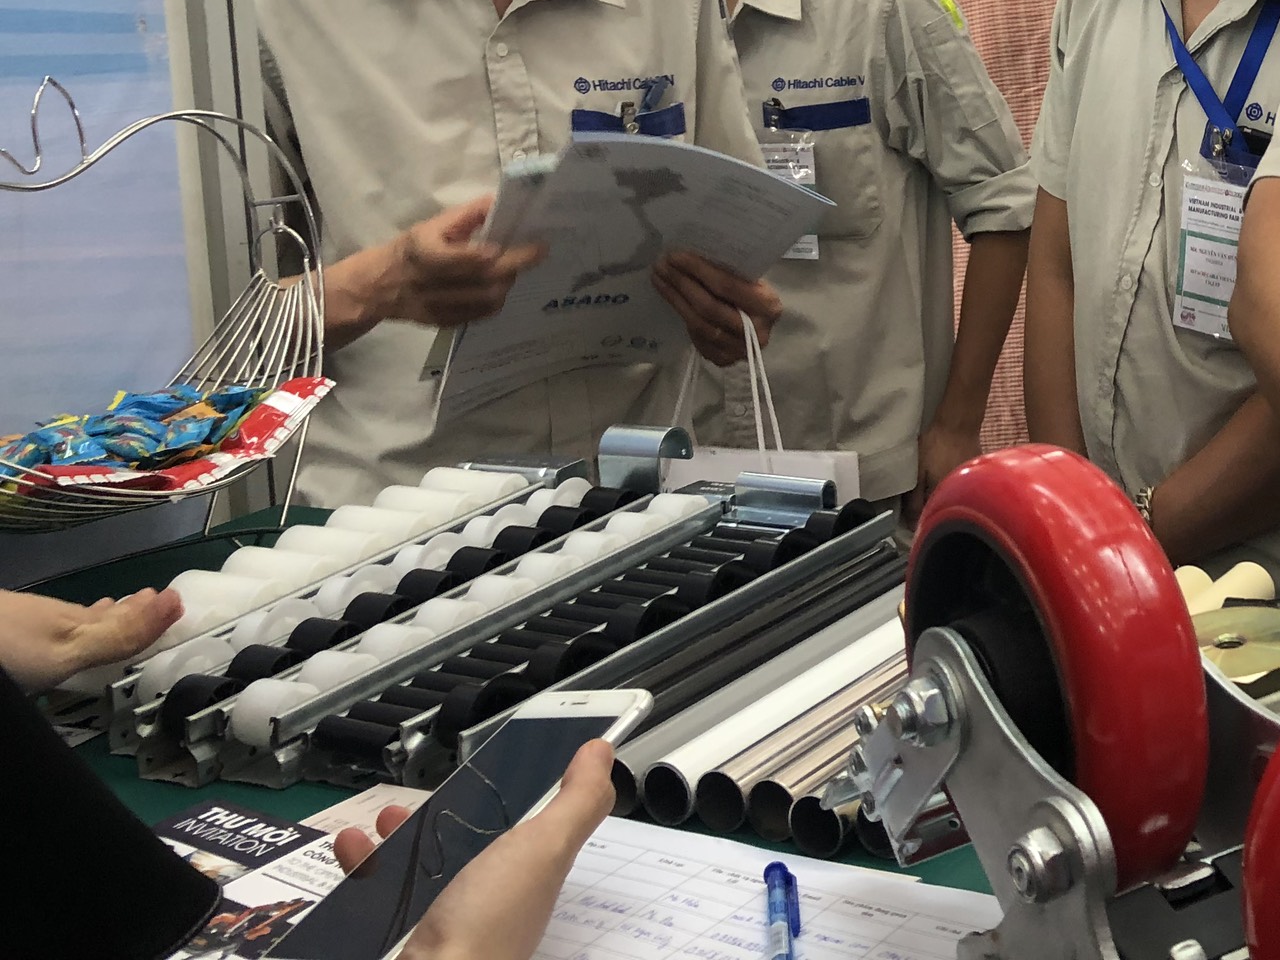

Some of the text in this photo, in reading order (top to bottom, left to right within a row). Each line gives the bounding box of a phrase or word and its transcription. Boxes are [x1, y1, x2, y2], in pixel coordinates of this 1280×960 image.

[592, 78, 632, 92] Hitachi
[787, 77, 824, 90] Hitachi
[824, 76, 857, 88] Cable
[1187, 205, 1229, 219] MANUFACTURING
[197, 806, 255, 831] THƯ
[243, 819, 303, 847] MỜI
[172, 817, 276, 858] INVITATION
